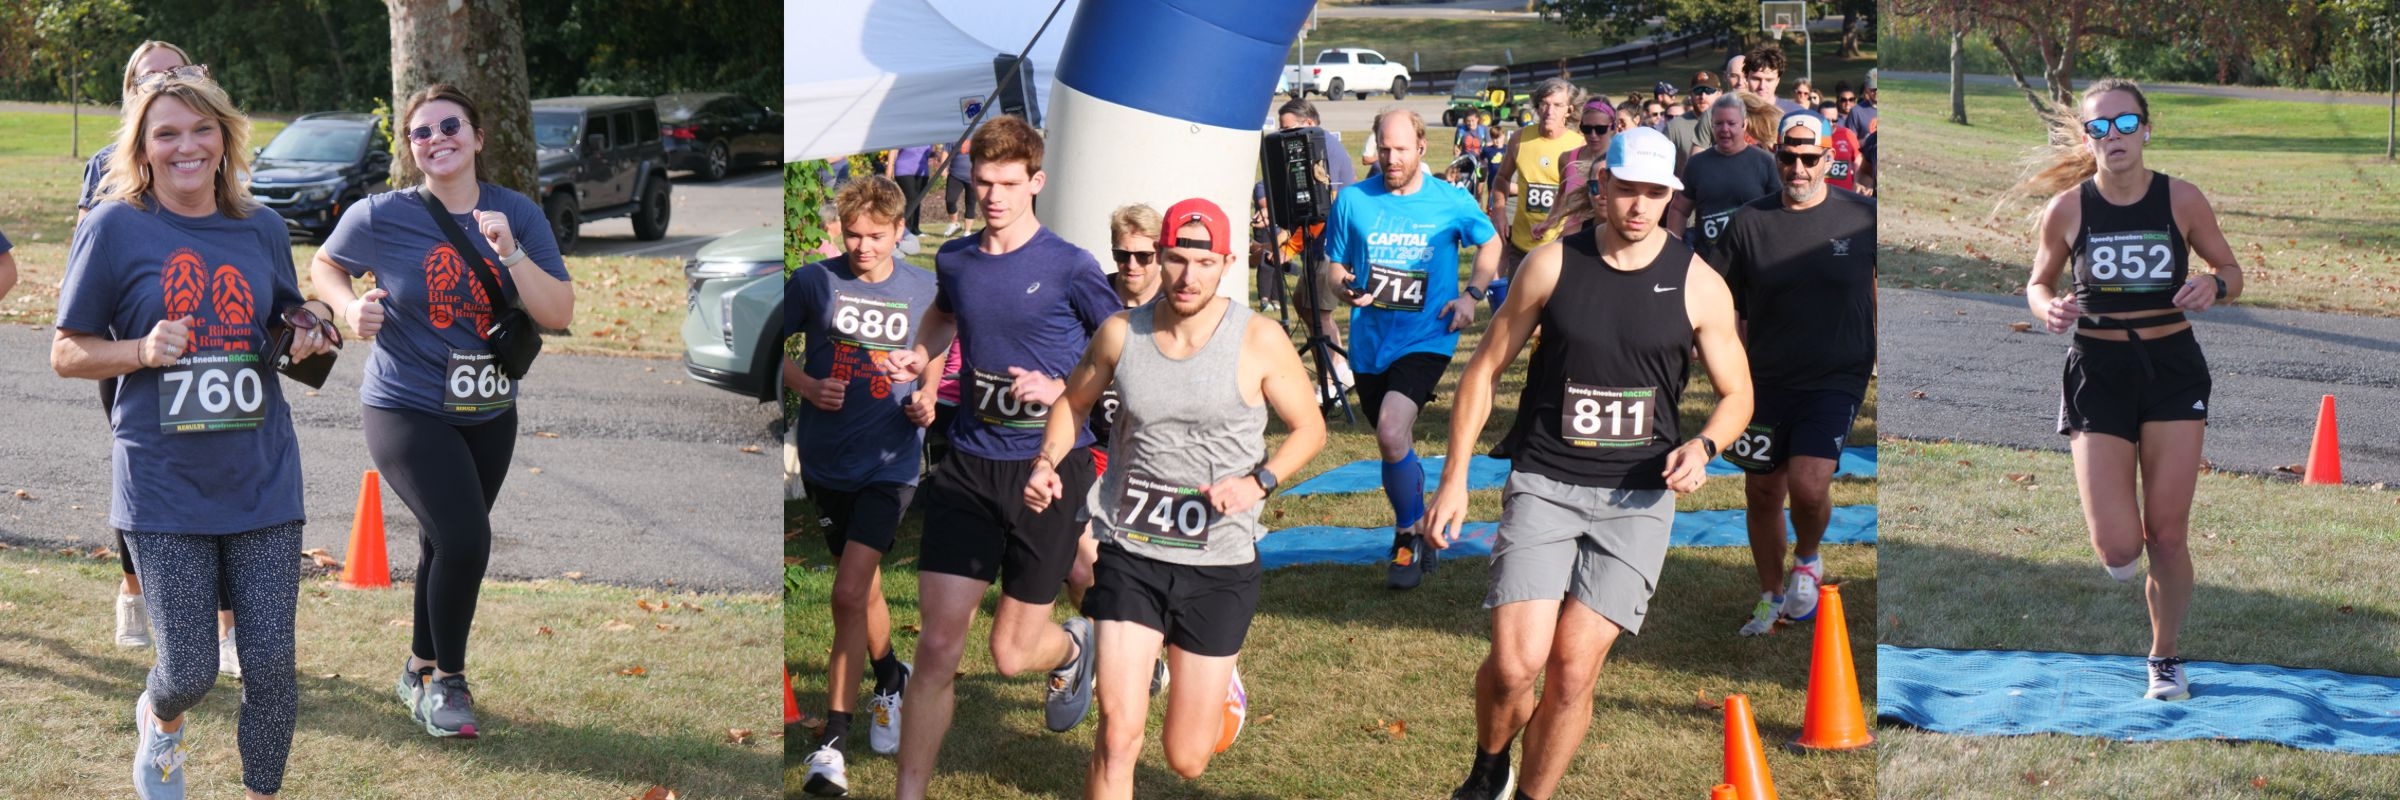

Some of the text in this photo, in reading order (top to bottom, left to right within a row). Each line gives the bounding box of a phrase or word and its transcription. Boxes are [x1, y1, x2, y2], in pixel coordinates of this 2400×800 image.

[1831, 163, 1848, 176] 82
[1528, 188, 1554, 207] 86
[1367, 232, 1428, 246] CAPITAL
[1703, 215, 1730, 238] 67
[2091, 244, 2172, 280] 852
[428, 291, 461, 303] Blue
[1372, 273, 1423, 304] 714
[208, 325, 251, 337] Ribbon
[836, 305, 908, 341] 680
[200, 335, 224, 347] Run
[192, 354, 229, 364] Sneakers
[163, 367, 263, 416] 760
[450, 364, 511, 398] 668
[1103, 398, 1119, 423] 8
[1573, 398, 1645, 436] 811
[1727, 432, 1771, 461] 62
[1124, 488, 1207, 537] 740
